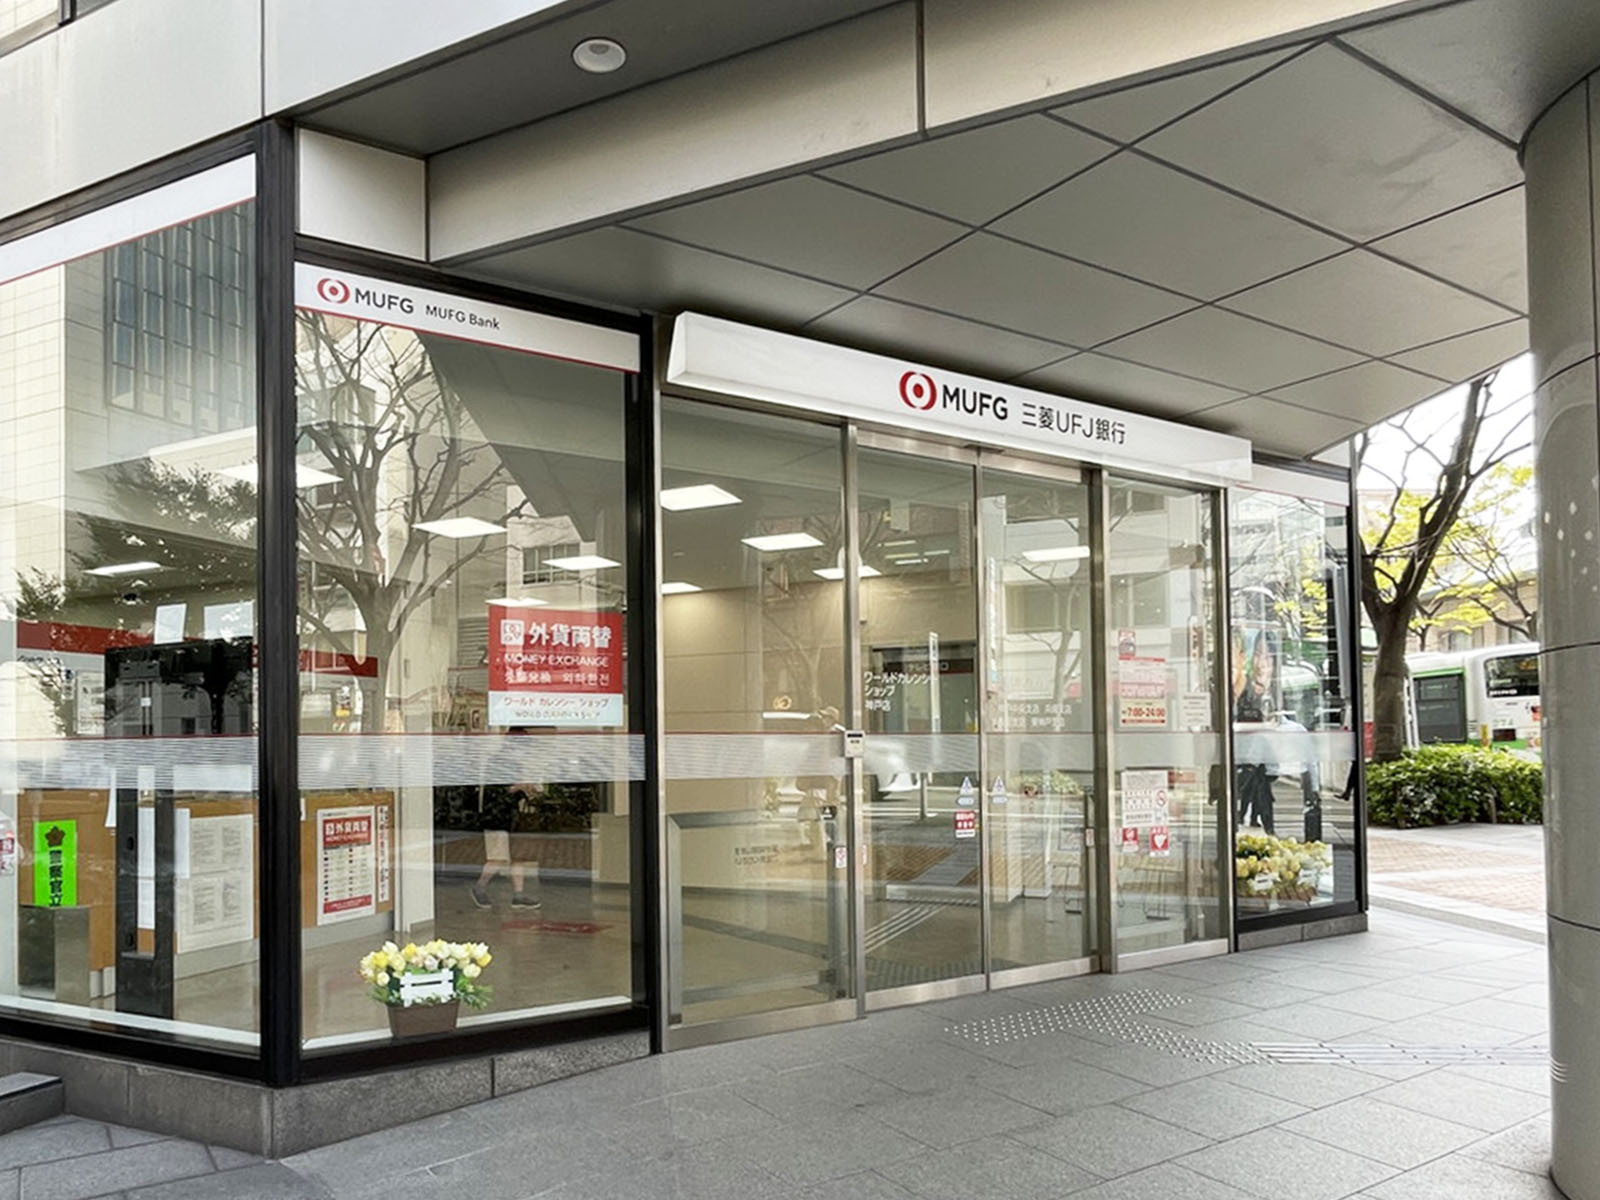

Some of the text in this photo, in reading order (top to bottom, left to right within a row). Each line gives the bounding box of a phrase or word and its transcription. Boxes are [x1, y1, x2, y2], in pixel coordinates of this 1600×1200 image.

[355, 287, 500, 331] MUFG MUFG Bank
[942, 384, 1126, 445] MUFG 三菱UFJ銀行
[529, 622, 611, 648] 外貨両替
[504, 653, 608, 668] MONEY EXCHANGE
[865, 685, 895, 697] ショップ
